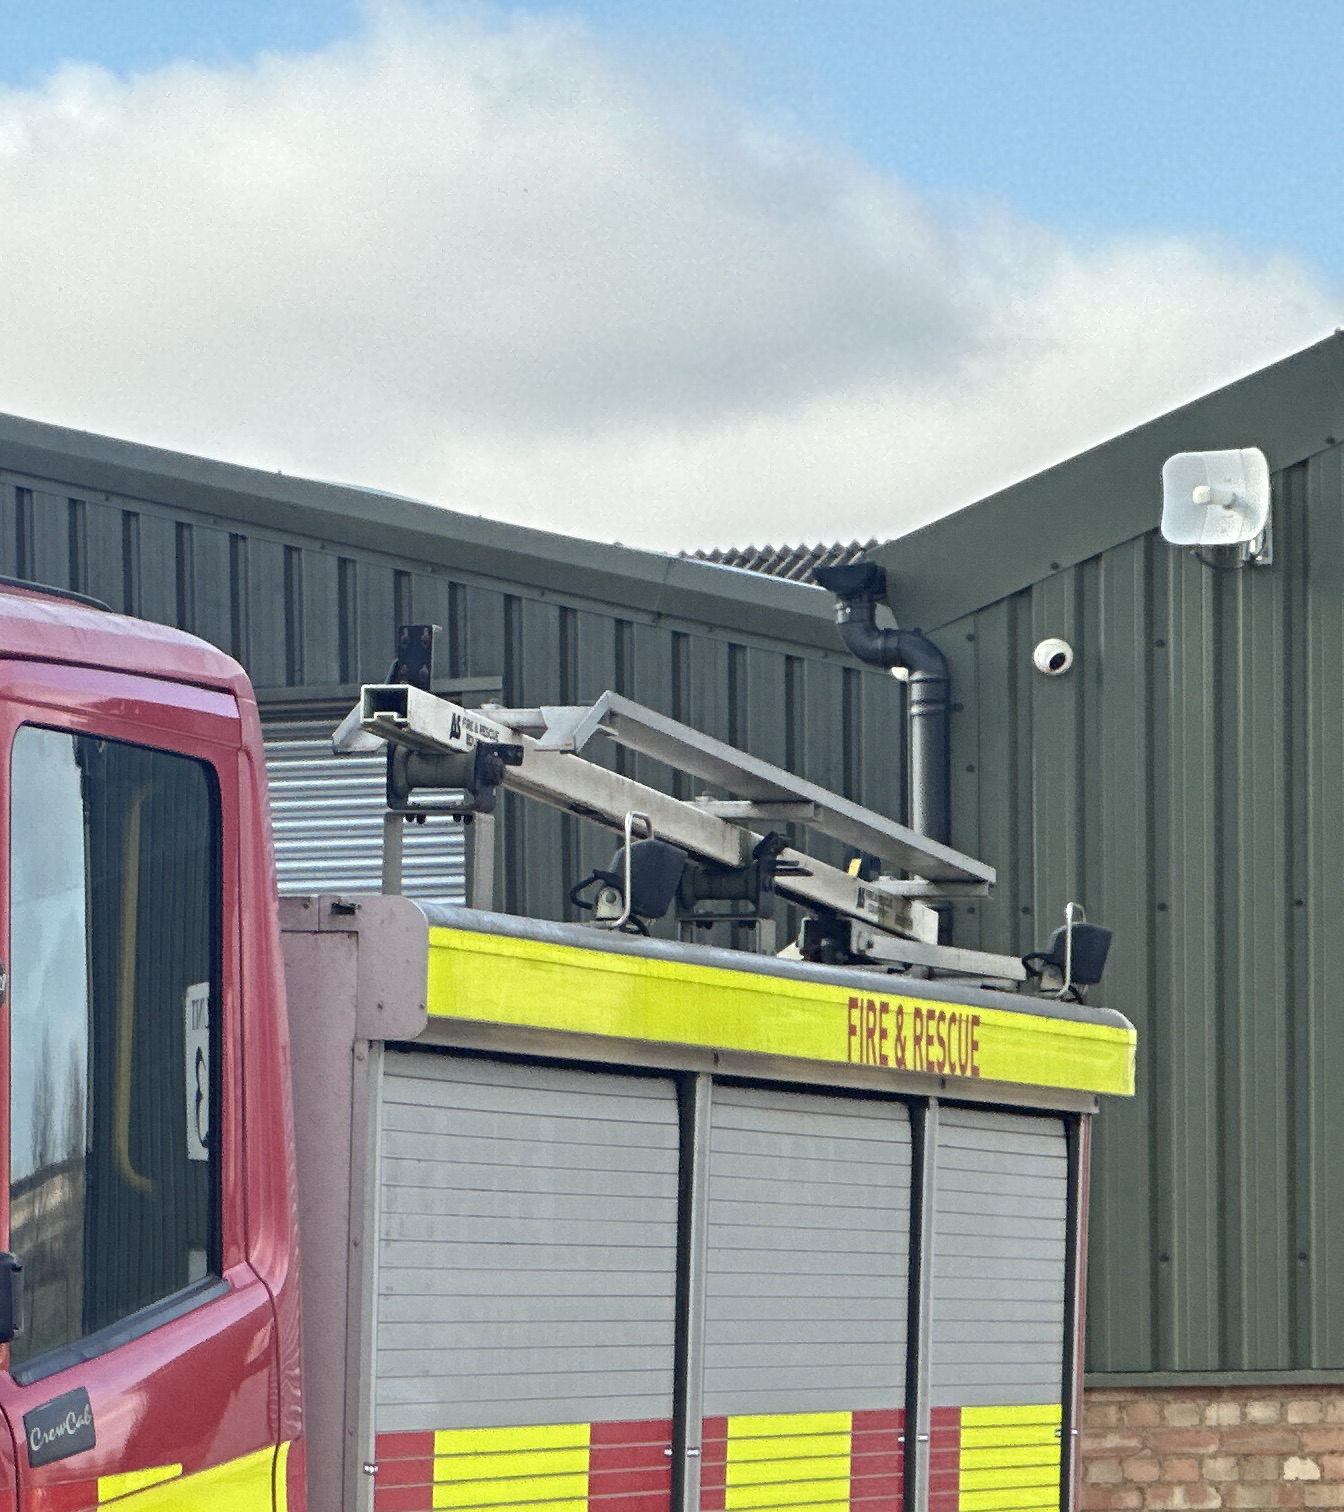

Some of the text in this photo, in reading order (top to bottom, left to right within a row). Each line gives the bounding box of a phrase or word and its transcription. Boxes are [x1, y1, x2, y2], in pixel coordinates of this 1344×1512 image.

[847, 995, 981, 1079] FIRE & RESCUE
